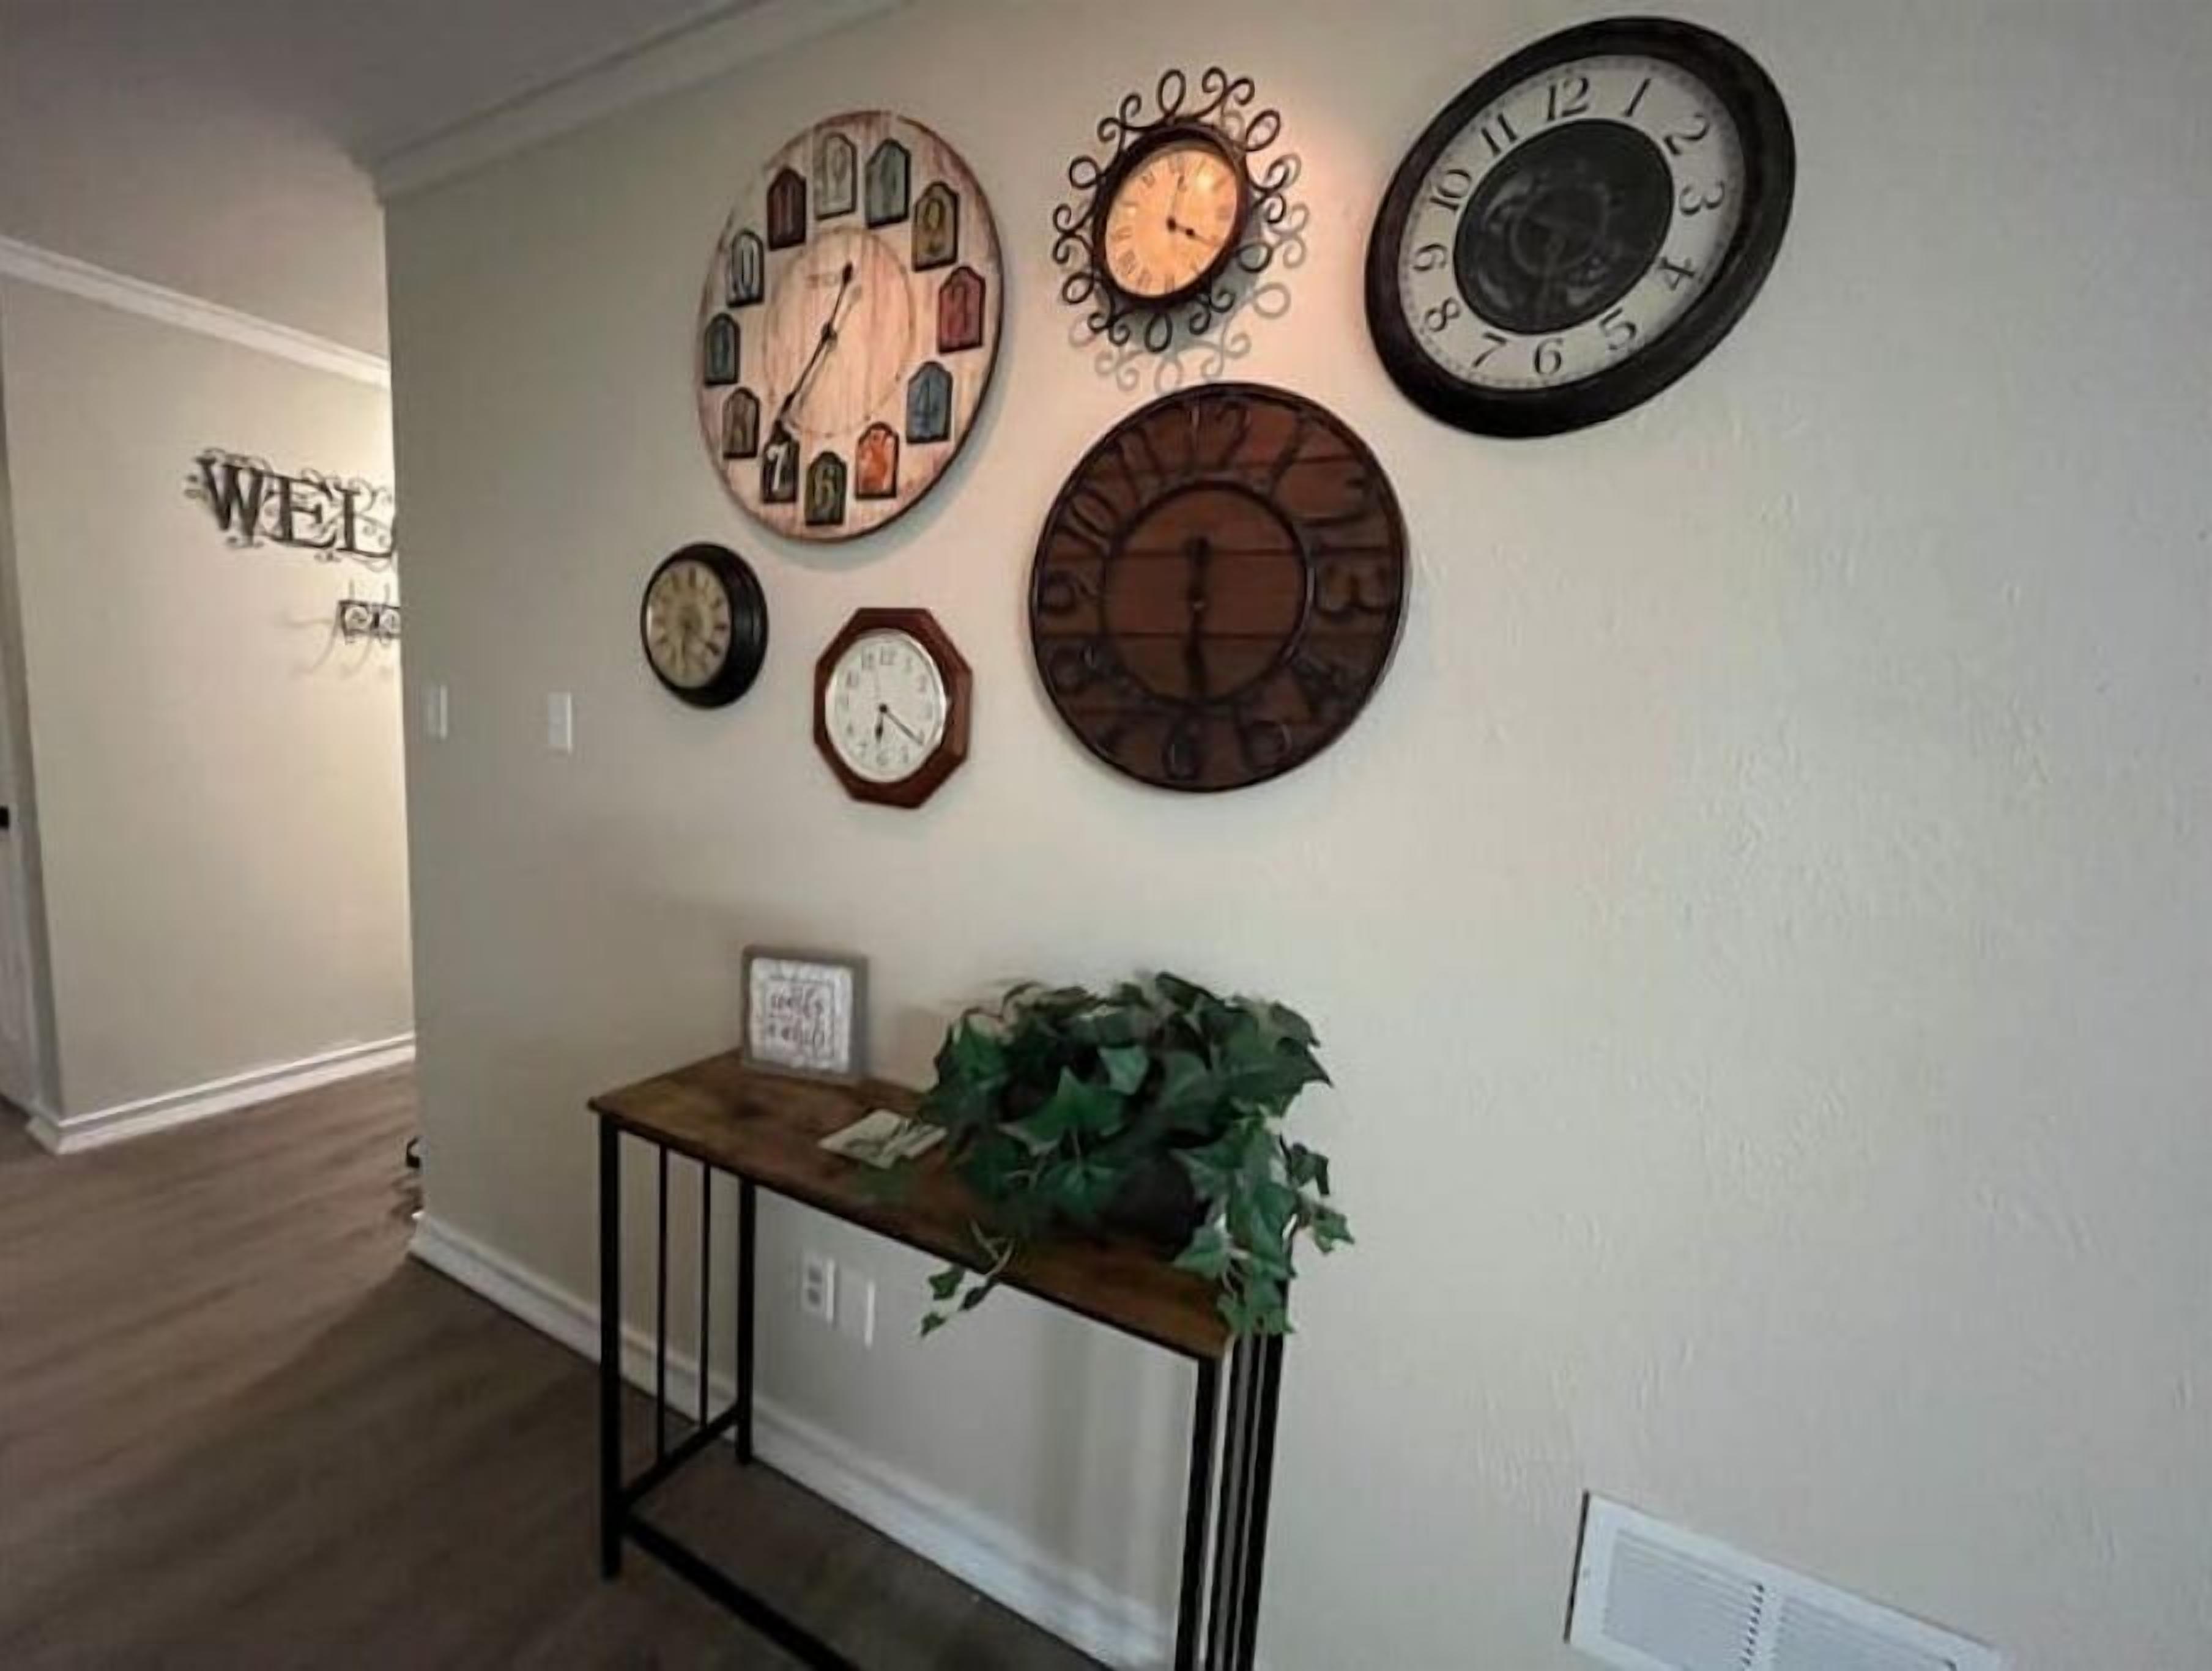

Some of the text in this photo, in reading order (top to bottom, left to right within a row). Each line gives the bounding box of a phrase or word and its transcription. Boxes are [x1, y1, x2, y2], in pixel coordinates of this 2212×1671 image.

[1546, 77, 1589, 121] 12
[1623, 78, 1651, 117] 1
[1480, 113, 1519, 157] 11
[1664, 113, 1710, 156] 2
[1429, 168, 1472, 212] 10
[1678, 180, 1725, 217] 3
[1412, 243, 1448, 273] 9
[1658, 255, 1696, 291] 4
[1423, 296, 1461, 333] 8
[1598, 307, 1639, 351] 5
[1473, 332, 1507, 368] 7
[1533, 337, 1564, 375] 6
[766, 443, 789, 491] 7
